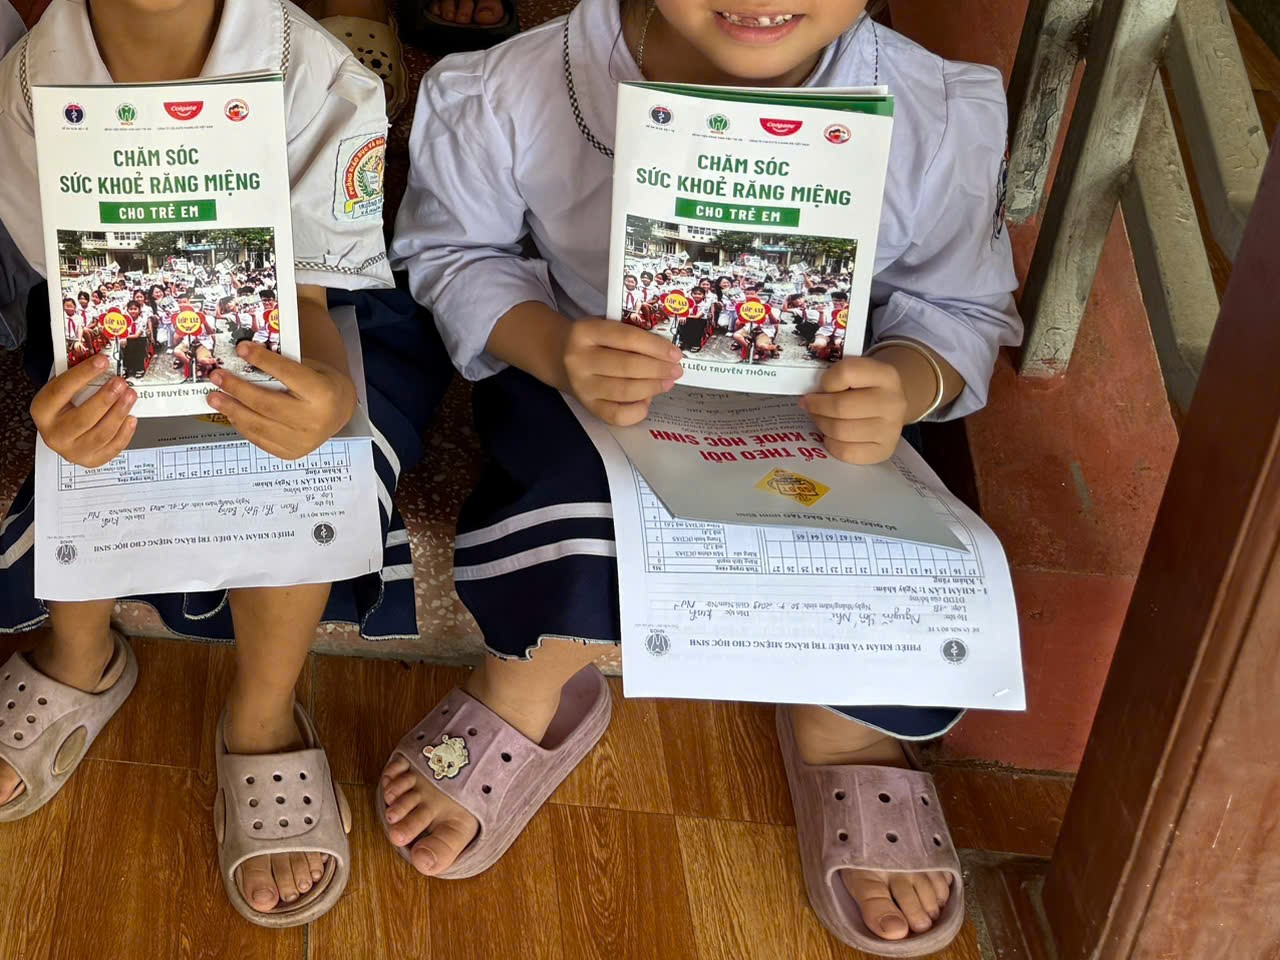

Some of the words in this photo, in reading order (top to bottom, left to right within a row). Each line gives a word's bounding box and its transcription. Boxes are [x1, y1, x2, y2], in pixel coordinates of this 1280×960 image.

[170, 104, 197, 114] Colgate
[113, 146, 160, 167] CHĂM
[166, 145, 199, 166] SÓC
[697, 154, 748, 174] CHĂM
[754, 157, 790, 176] SÓC
[60, 171, 93, 194] SỨC
[97, 172, 144, 194] KHOẺ
[150, 172, 198, 194] RĂNG
[204, 169, 260, 196] MIỆNG
[636, 166, 671, 188] SỨC
[677, 175, 726, 197] KHOẺ
[732, 179, 784, 200] RĂNG
[791, 183, 851, 208] MIỆNG
[119, 208, 144, 219] CHO
[150, 203, 175, 218] TRẺ
[182, 206, 198, 217] EM
[696, 205, 723, 218] CHO
[729, 207, 755, 220] TRẺ
[762, 211, 781, 222] EM
[745, 367, 777, 377] THÔNG
[649, 430, 699, 445] SINH
[704, 434, 747, 447] HỌC
[740, 449, 795, 460] THEO
